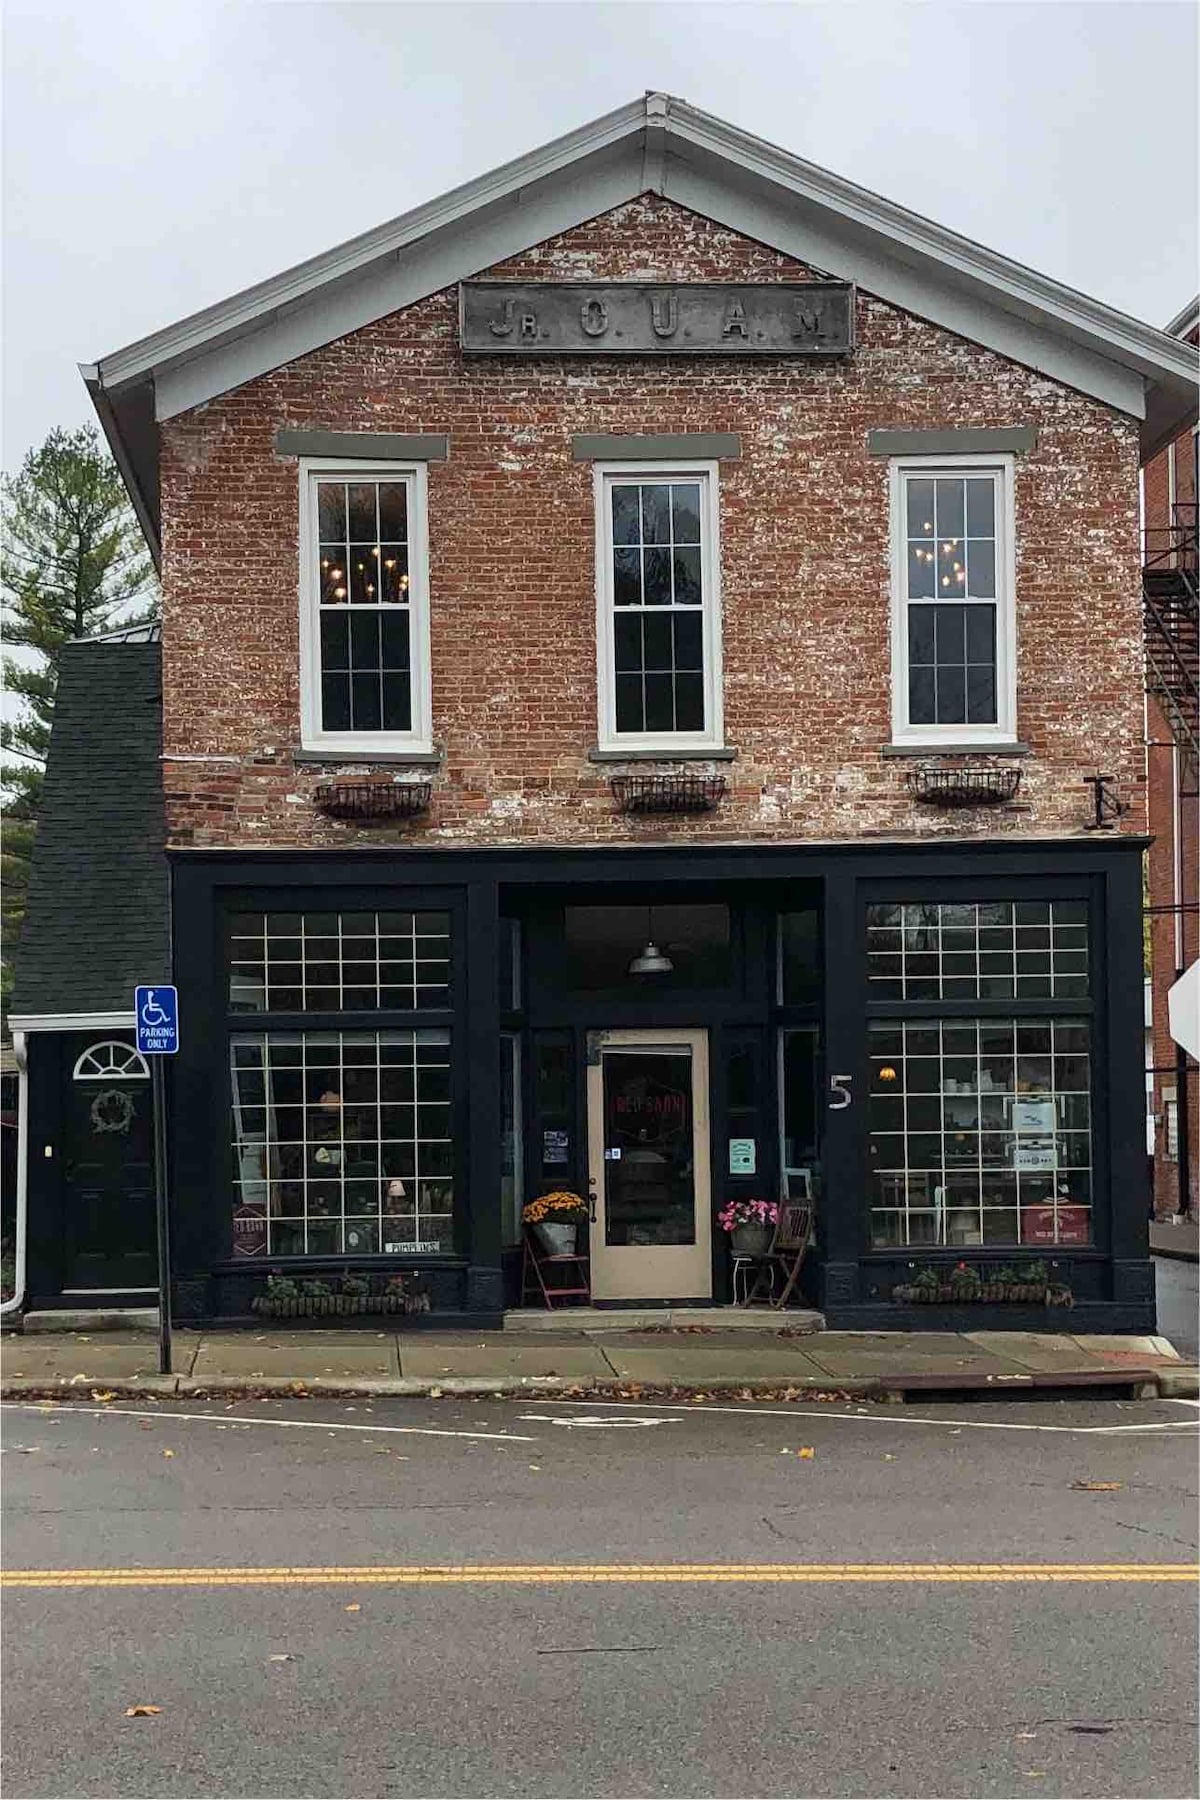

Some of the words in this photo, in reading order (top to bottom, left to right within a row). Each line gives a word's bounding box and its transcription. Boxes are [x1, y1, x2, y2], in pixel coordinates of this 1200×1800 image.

[140, 1027, 175, 1038] PARKING
[147, 1039, 168, 1049] ONLY
[828, 1075, 852, 1109] 5
